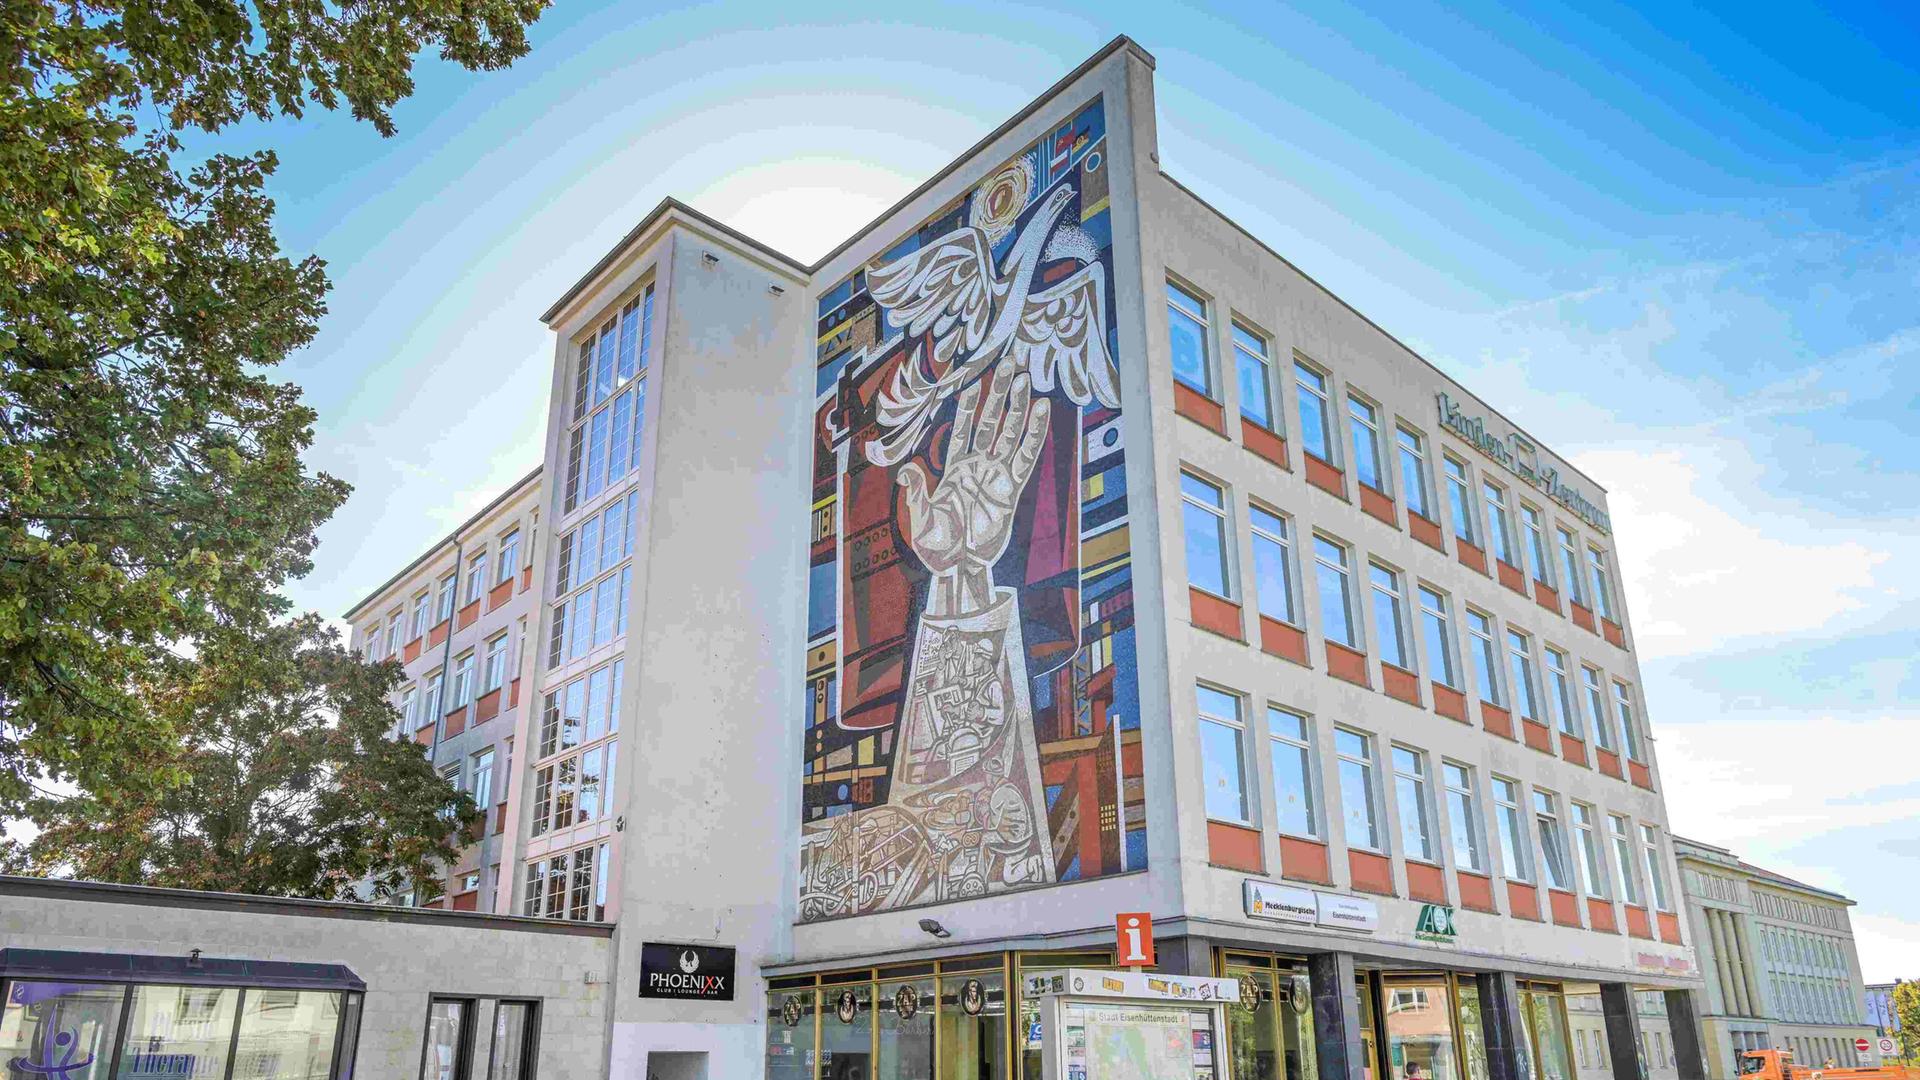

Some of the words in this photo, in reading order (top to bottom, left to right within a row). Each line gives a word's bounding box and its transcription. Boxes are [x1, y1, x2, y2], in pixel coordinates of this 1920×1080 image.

[1264, 901, 1316, 916] Mecklenburgische
[1422, 904, 1458, 936] AOK
[1124, 917, 1147, 961] i
[649, 972, 725, 993] PHOENIXX
[1098, 1012, 1118, 1022] Stadt
[1119, 1012, 1178, 1024] Eisenhüttenstadt
